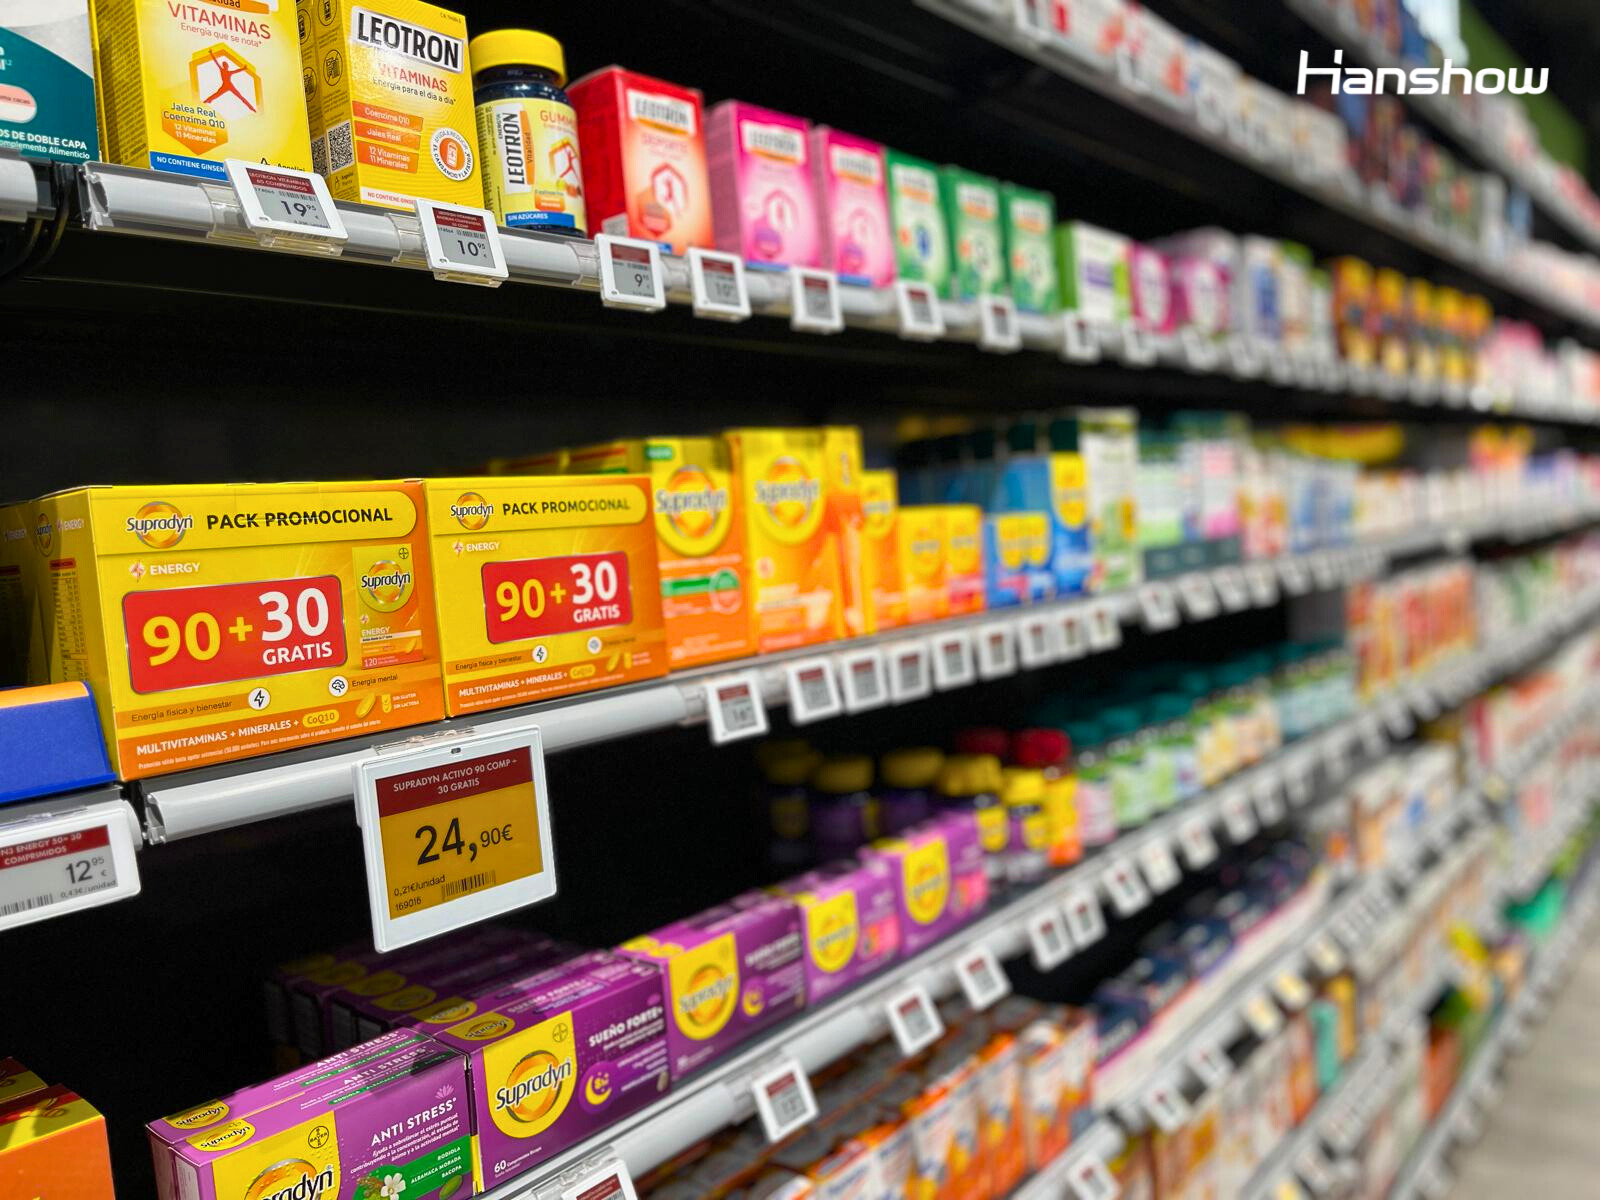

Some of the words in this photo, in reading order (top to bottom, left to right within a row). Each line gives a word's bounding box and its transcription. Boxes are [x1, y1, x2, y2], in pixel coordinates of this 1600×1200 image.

[167, 1, 271, 40] VITAMINAS
[213, 31, 229, 40] que
[230, 35, 240, 43] se
[357, 12, 460, 69] LEOTRON
[378, 62, 448, 92] VITAMINAS
[402, 85, 419, 95] para
[163, 110, 207, 127] Coenzima
[208, 119, 226, 129] Q10
[171, 102, 195, 114] Jalea
[197, 107, 217, 118] Real
[11, 130, 26, 141] DE
[27, 133, 60, 147] DOBLE
[61, 139, 87, 151] CAPA
[502, 112, 525, 185] LEOTRON
[48, 146, 91, 160] Alimenticio
[377, 148, 410, 162] Vitaminas
[157, 156, 167, 164] NO
[167, 158, 201, 170] CONTIENE
[280, 200, 306, 217] 19
[507, 213, 519, 221] SIN
[457, 239, 478, 257] 10
[451, 502, 494, 518] Supradyn
[502, 502, 538, 516] PACK
[541, 498, 631, 514] PROMOCIONAL
[126, 513, 193, 534] Supradyn
[206, 512, 260, 530] PACK
[265, 508, 393, 527] PROMOCIONAL
[466, 542, 500, 552] ENERGY
[150, 562, 201, 576] ENERGY
[361, 571, 411, 590] Supradyn
[496, 578, 546, 622] 90
[550, 583, 566, 604] +
[570, 560, 618, 605] 30
[572, 604, 621, 623] GRATIS
[143, 611, 221, 667] 90
[229, 616, 253, 642] +
[258, 587, 329, 642] 30
[262, 641, 333, 666] GRATIS
[364, 657, 378, 668] 120
[377, 674, 398, 684] mental
[459, 679, 520, 698] MULTIVITAMINAS
[526, 671, 563, 686] MINERALES
[189, 708, 195, 717] y
[196, 699, 233, 713] bienestar
[136, 730, 228, 756] MULTIVITAMINAS
[238, 719, 292, 737] MINERALES
[307, 712, 335, 726] CoQ10
[393, 774, 441, 792] SUPRADYN
[442, 767, 473, 781] ACTIVO
[474, 764, 485, 773] 90
[486, 758, 511, 772] COMP
[437, 786, 449, 795] 30
[450, 778, 480, 792] GRATIS
[4, 845, 67, 865] COMPRIMIDOS
[16, 840, 50, 853] ENERGY
[65, 860, 93, 884] 12
[395, 897, 422, 912] 169016
[588, 1021, 626, 1047] SUEÑO
[316, 1051, 349, 1068] ANTI
[343, 1068, 376, 1085] ANTI
[496, 1060, 571, 1111] Supradyn
[176, 1106, 225, 1127] Supradyn
[200, 1126, 250, 1148] Supradyn
[371, 1122, 404, 1146] ANTI
[420, 1134, 442, 1148] actividad
[350, 1154, 386, 1174] contribuyendo
[437, 1123, 452, 1134] estado
[437, 1146, 461, 1161] RODIOLA
[411, 1167, 438, 1184] ALBAHACA
[439, 1155, 462, 1170] MORADA
[441, 1164, 462, 1178] BACOPA
[494, 1159, 507, 1173] 60
